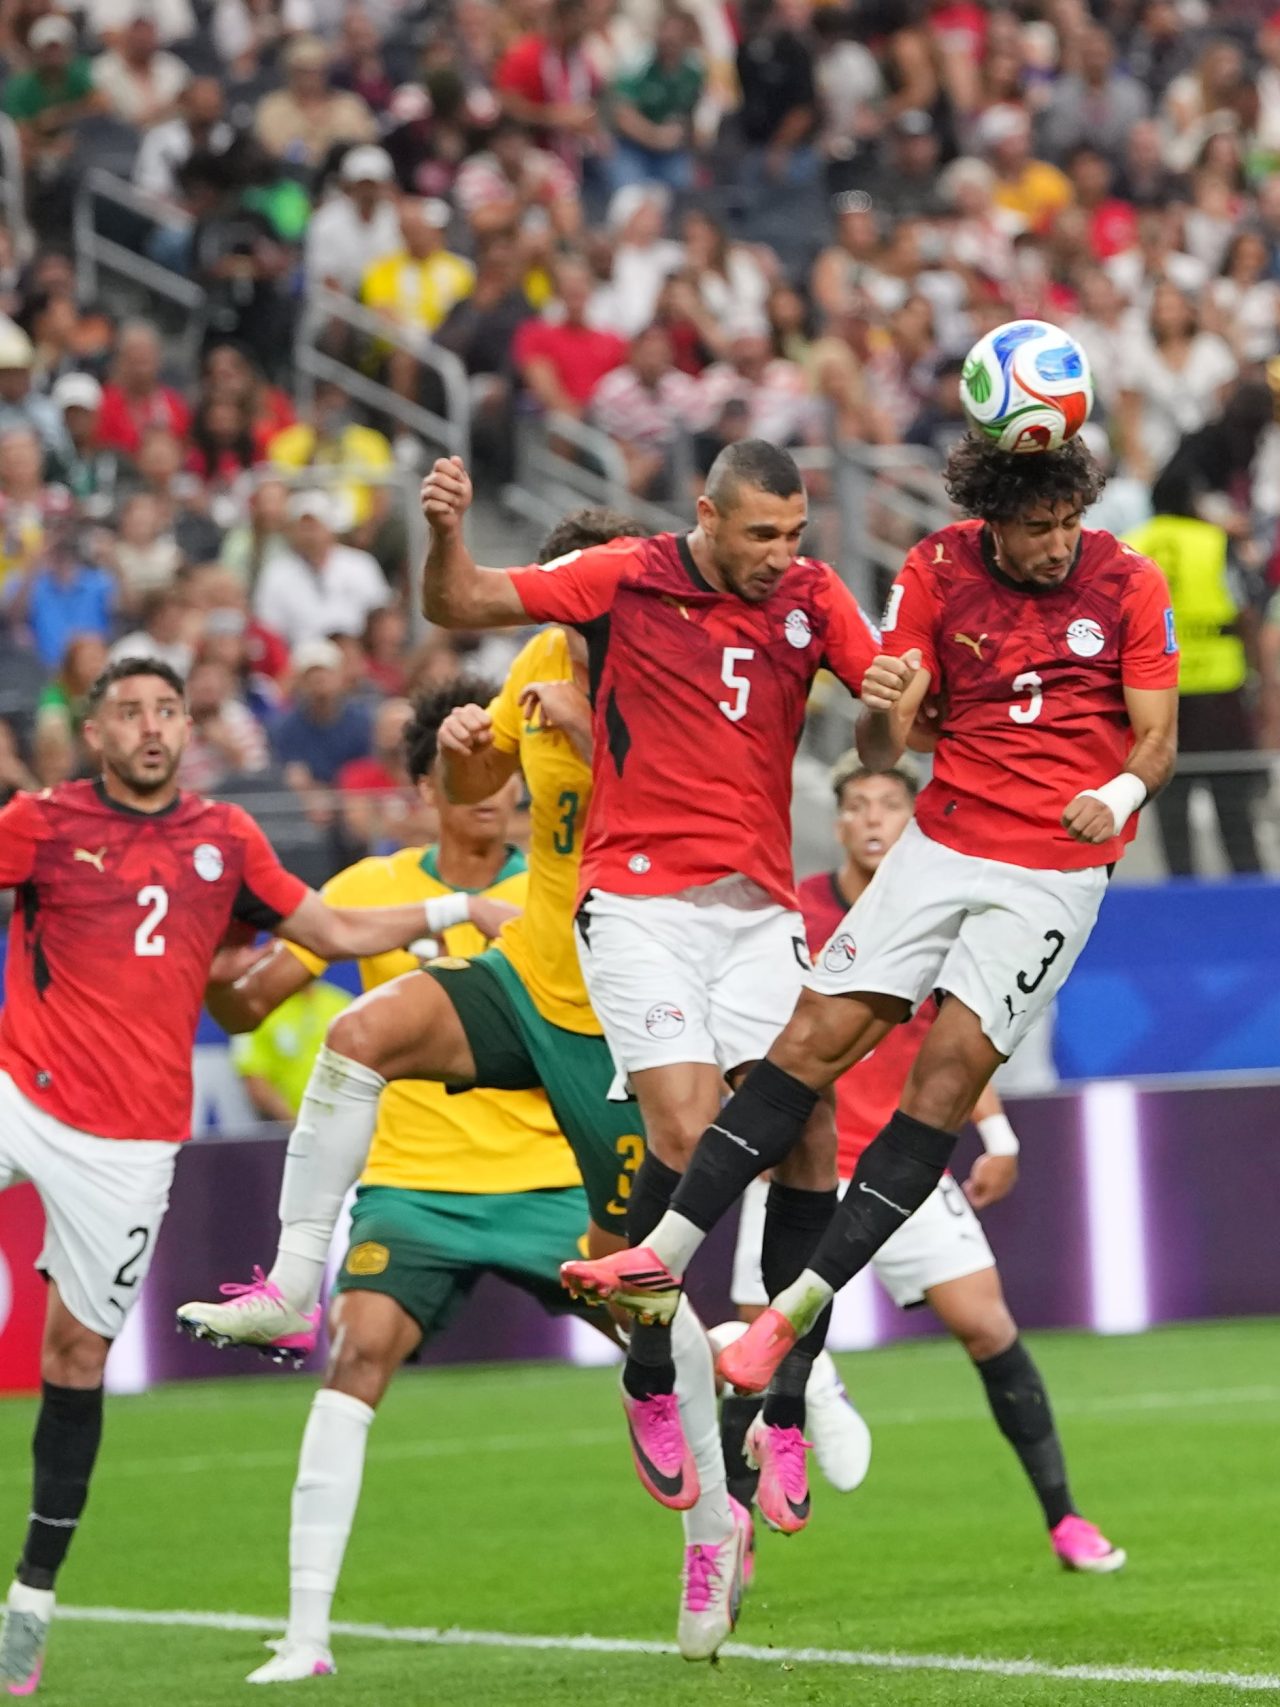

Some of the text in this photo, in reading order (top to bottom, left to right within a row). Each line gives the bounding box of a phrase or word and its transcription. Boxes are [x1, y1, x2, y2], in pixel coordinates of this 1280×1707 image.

[719, 647, 755, 722] 5
[1008, 671, 1044, 724] 3
[552, 791, 578, 855] 3
[135, 884, 169, 956] 2
[1016, 929, 1066, 994] 3
[616, 1134, 646, 1199] 3
[112, 1226, 150, 1288] 2
